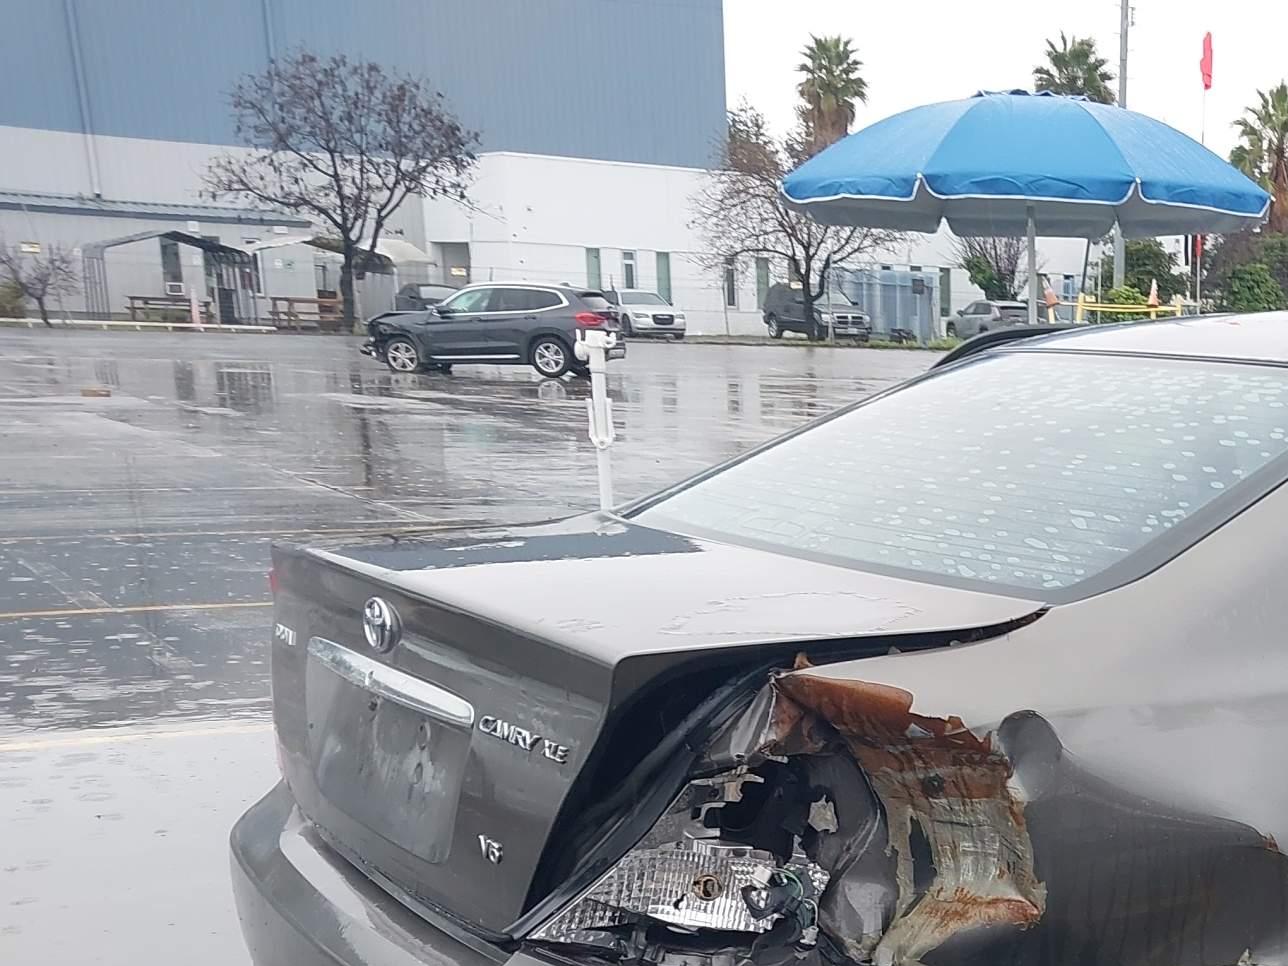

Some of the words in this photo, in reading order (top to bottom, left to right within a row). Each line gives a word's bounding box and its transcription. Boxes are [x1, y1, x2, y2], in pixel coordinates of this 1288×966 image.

[479, 715, 542, 751] CAMRY
[541, 739, 570, 765] XLE
[478, 834, 503, 864] V6
